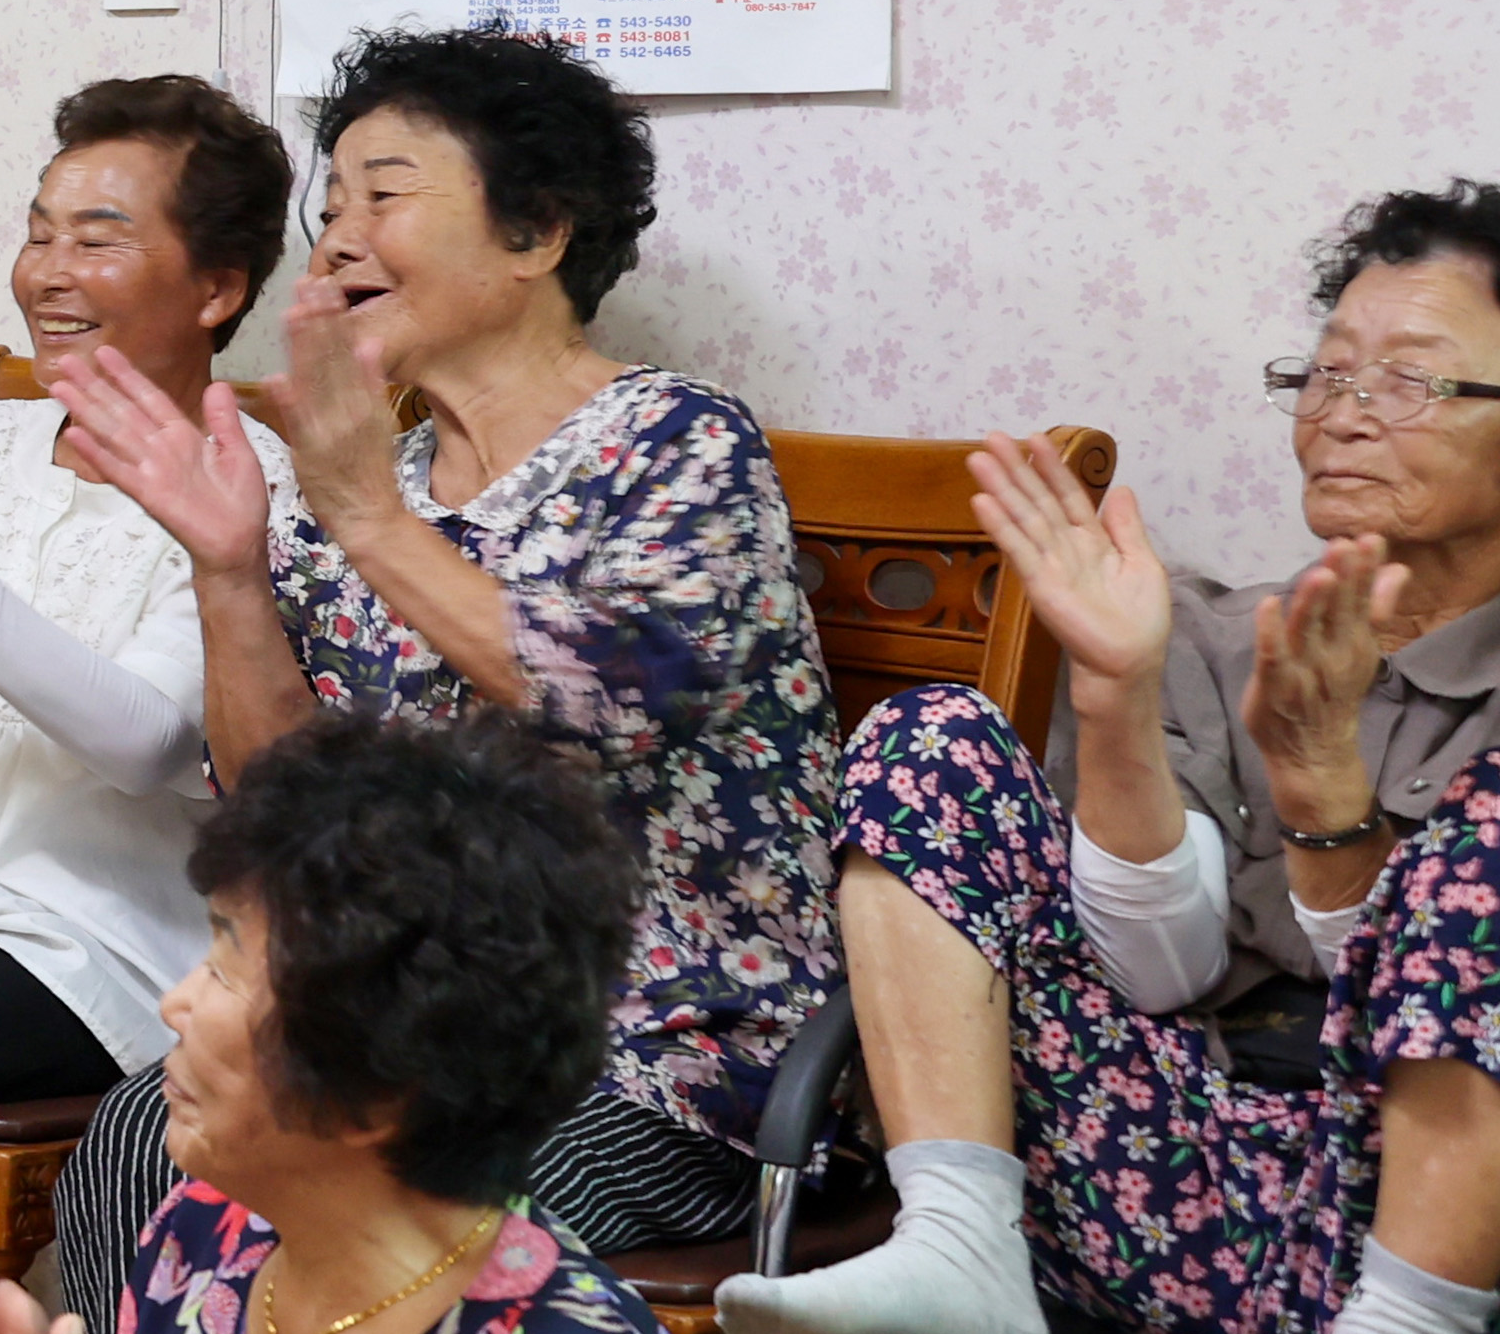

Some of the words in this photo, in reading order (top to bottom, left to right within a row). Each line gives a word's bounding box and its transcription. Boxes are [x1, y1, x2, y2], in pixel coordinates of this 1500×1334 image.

[538, 17, 587, 31] 주유소
[619, 15, 692, 28] 543-5430
[619, 31, 691, 43] 543-8081
[619, 46, 692, 58] 542-6465
